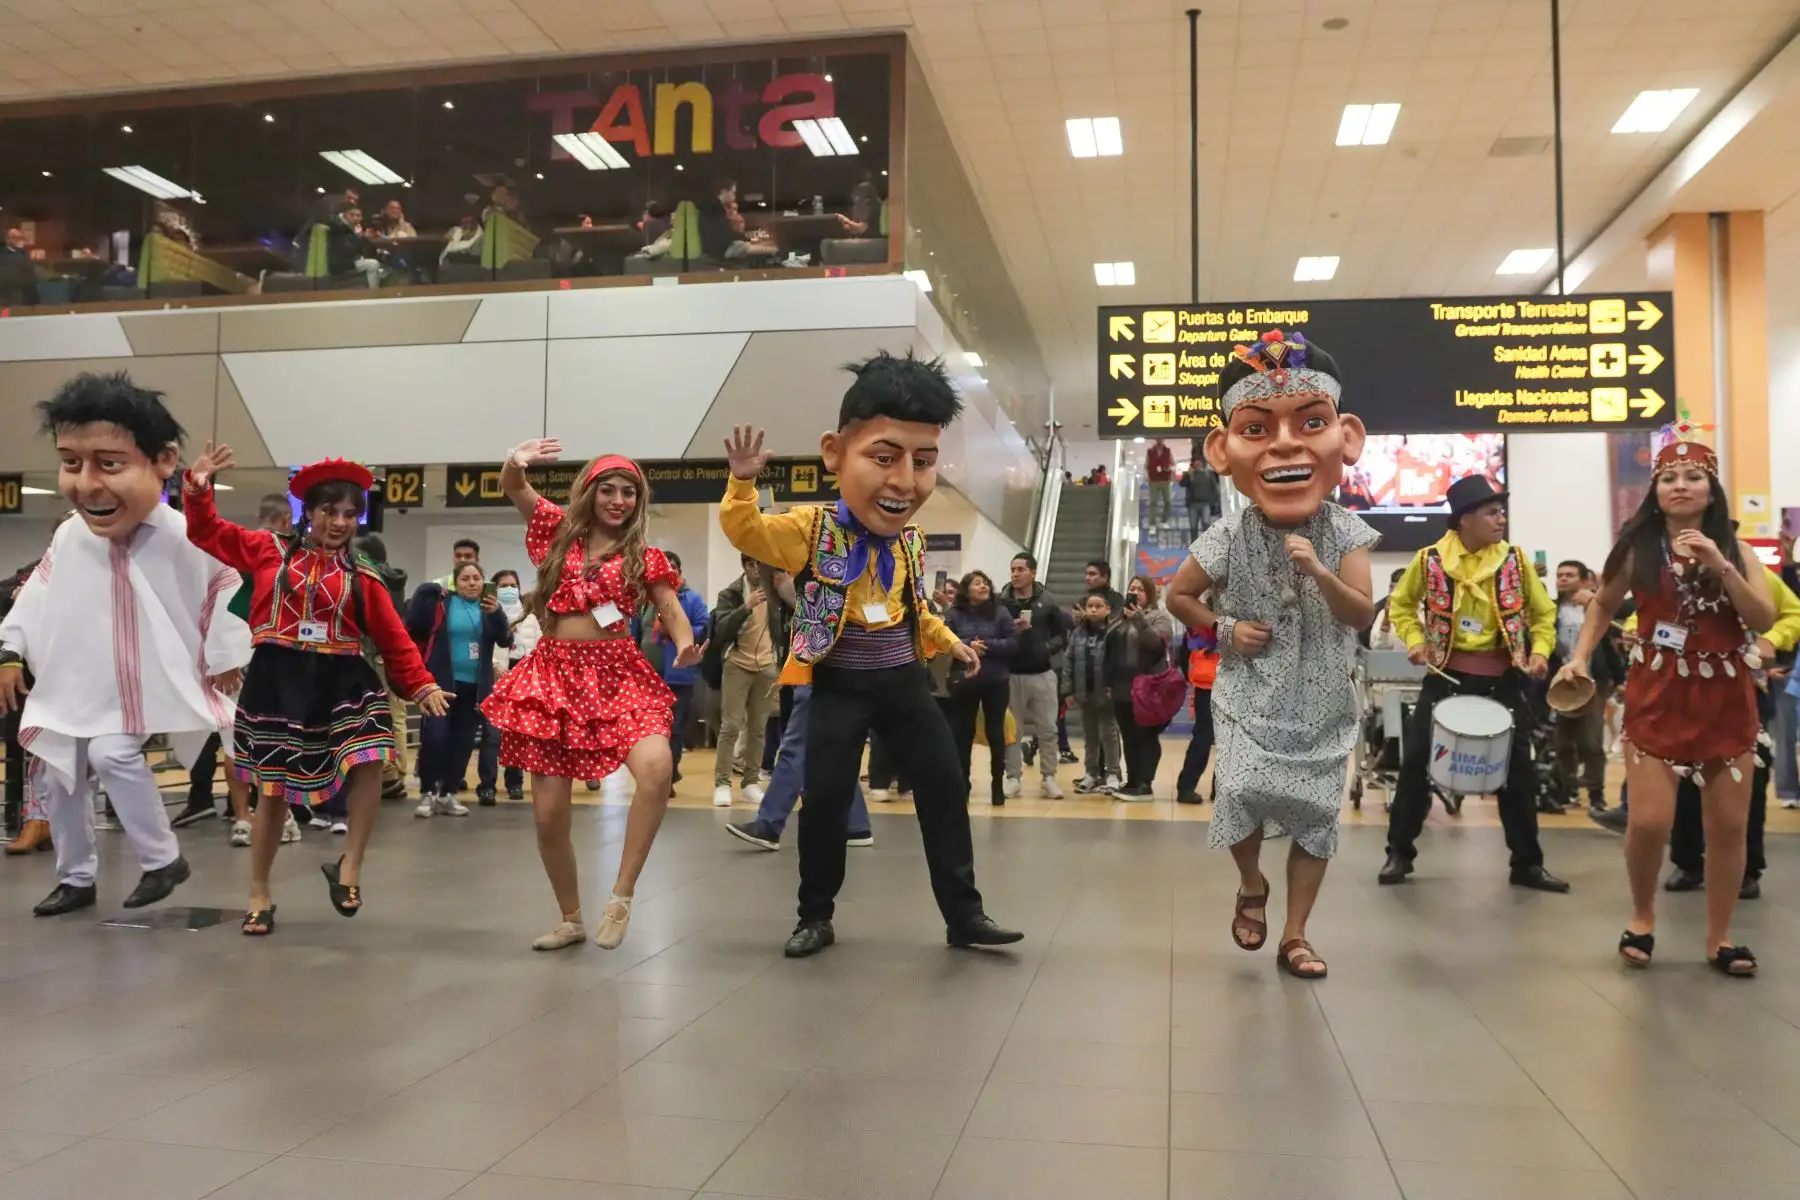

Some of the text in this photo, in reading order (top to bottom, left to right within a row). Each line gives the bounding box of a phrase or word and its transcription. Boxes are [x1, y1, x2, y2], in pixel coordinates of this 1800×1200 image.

[1178, 308, 1309, 326] Puertas de Embarque
[1430, 301, 1588, 322] Transporte Terrestre
[1177, 328, 1258, 344] Departure Gates
[1454, 321, 1588, 338] Ground Transportation
[1178, 349, 1208, 369] Área
[1209, 351, 1226, 368] de
[1493, 345, 1548, 363] Sanidad
[1177, 371, 1220, 388] Shoppin
[1514, 364, 1589, 379] Health Center
[1178, 394, 1214, 411] Venta
[1455, 388, 1589, 409] Llegadas Nacionales
[1179, 414, 1208, 428] Ticket
[1497, 408, 1548, 423] Domestic
[648, 467, 730, 480] Control de Preemb
[386, 472, 420, 503] 62
[1451, 751, 1488, 765] LIMA
